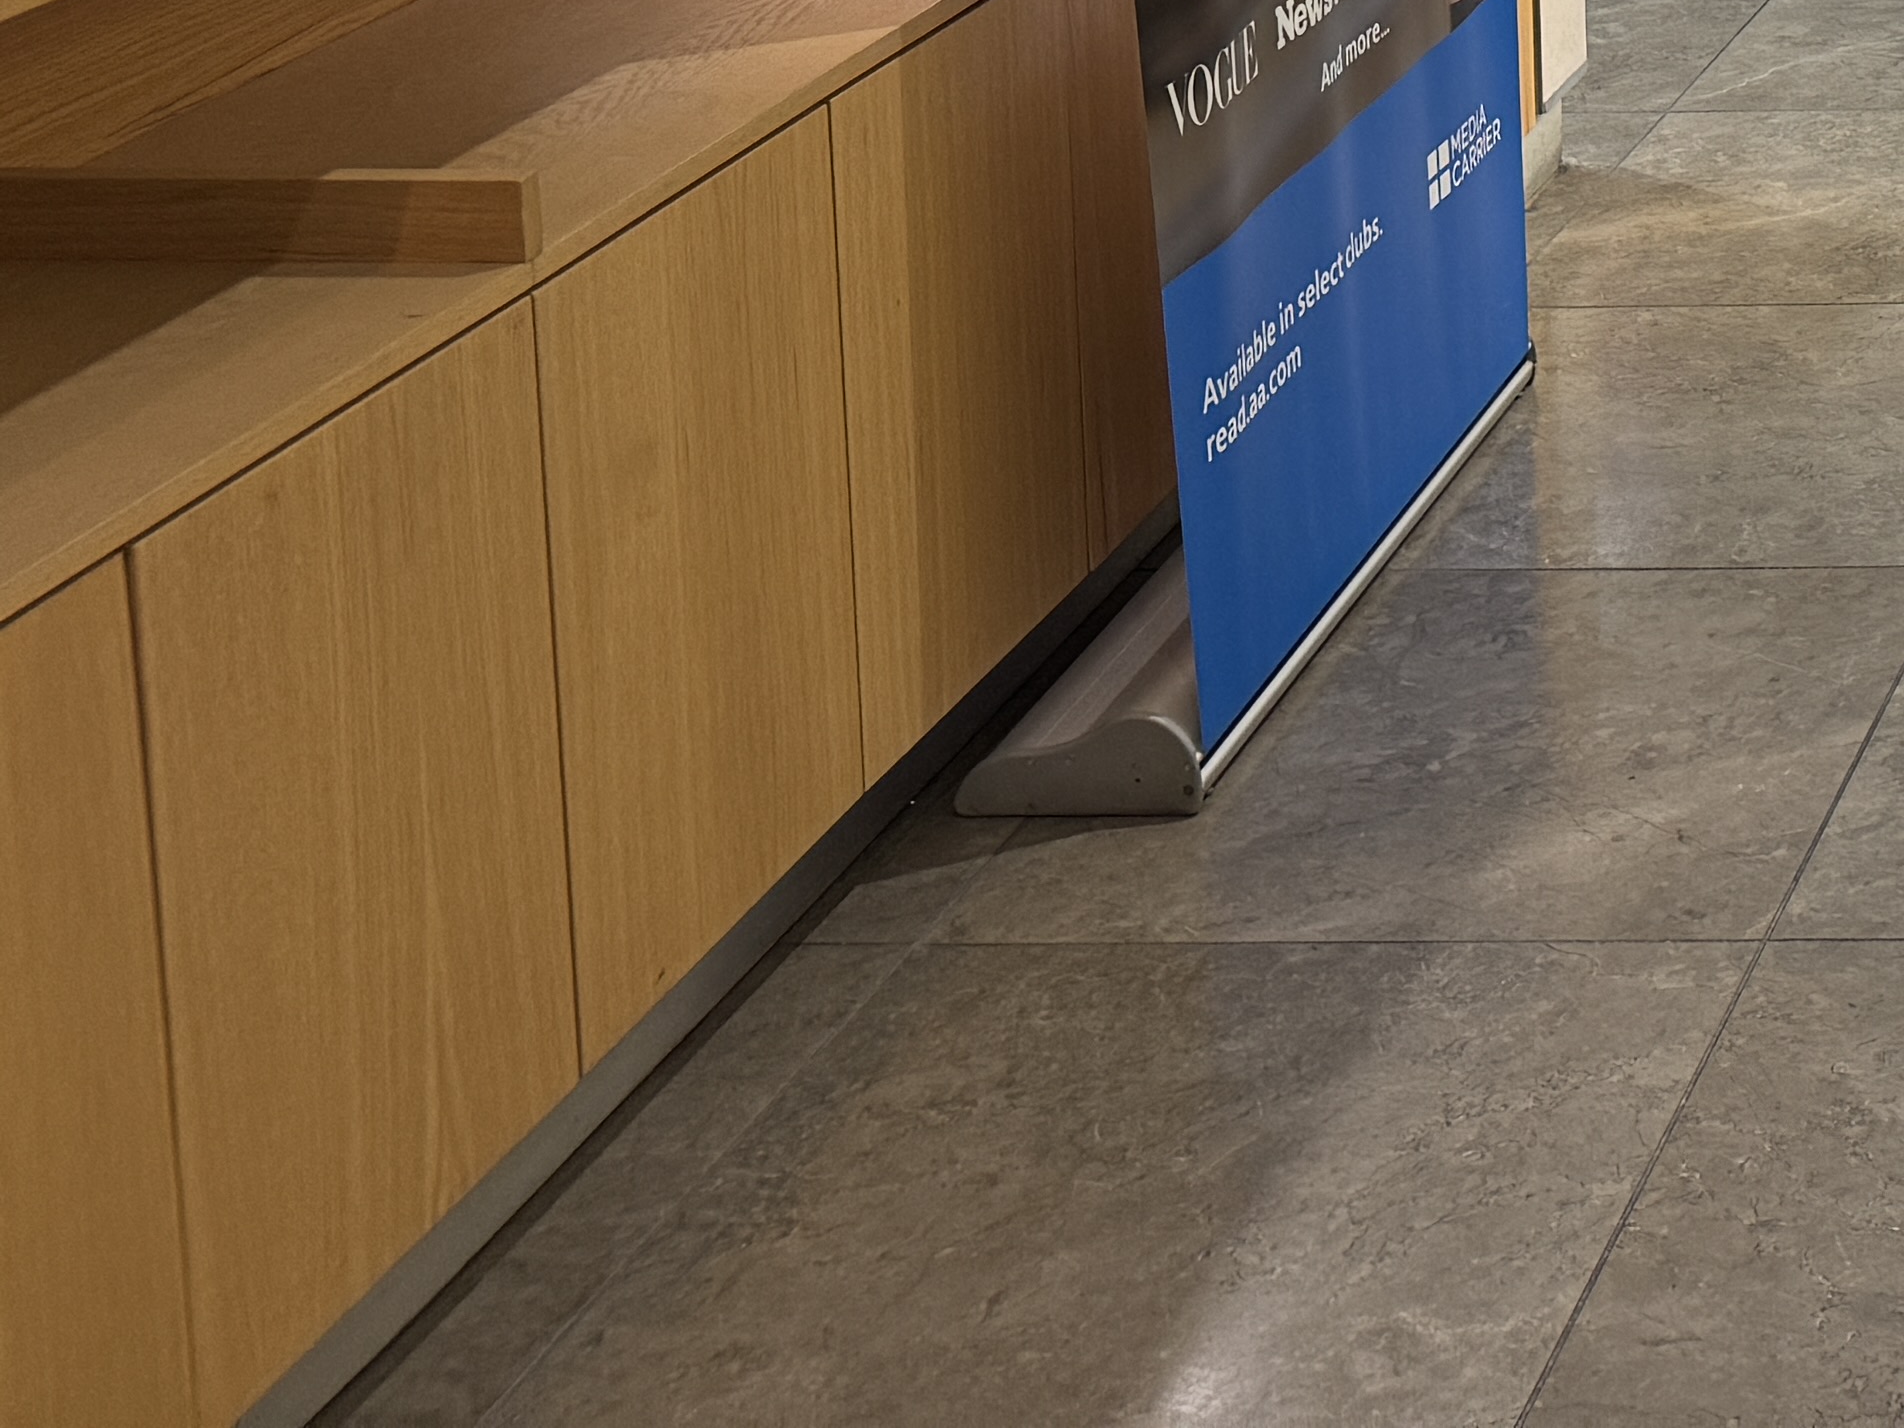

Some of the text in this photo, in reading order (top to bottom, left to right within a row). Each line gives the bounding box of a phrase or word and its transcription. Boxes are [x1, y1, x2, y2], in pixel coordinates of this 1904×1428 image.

[1166, 20, 1259, 137] VOGUE
[1321, 45, 1343, 92] And
[1450, 104, 1487, 160] MEDIA
[1452, 118, 1501, 186] CARRIER
[1203, 216, 1384, 414] Available in select clubs.
[1206, 344, 1302, 462] read.aa.com
